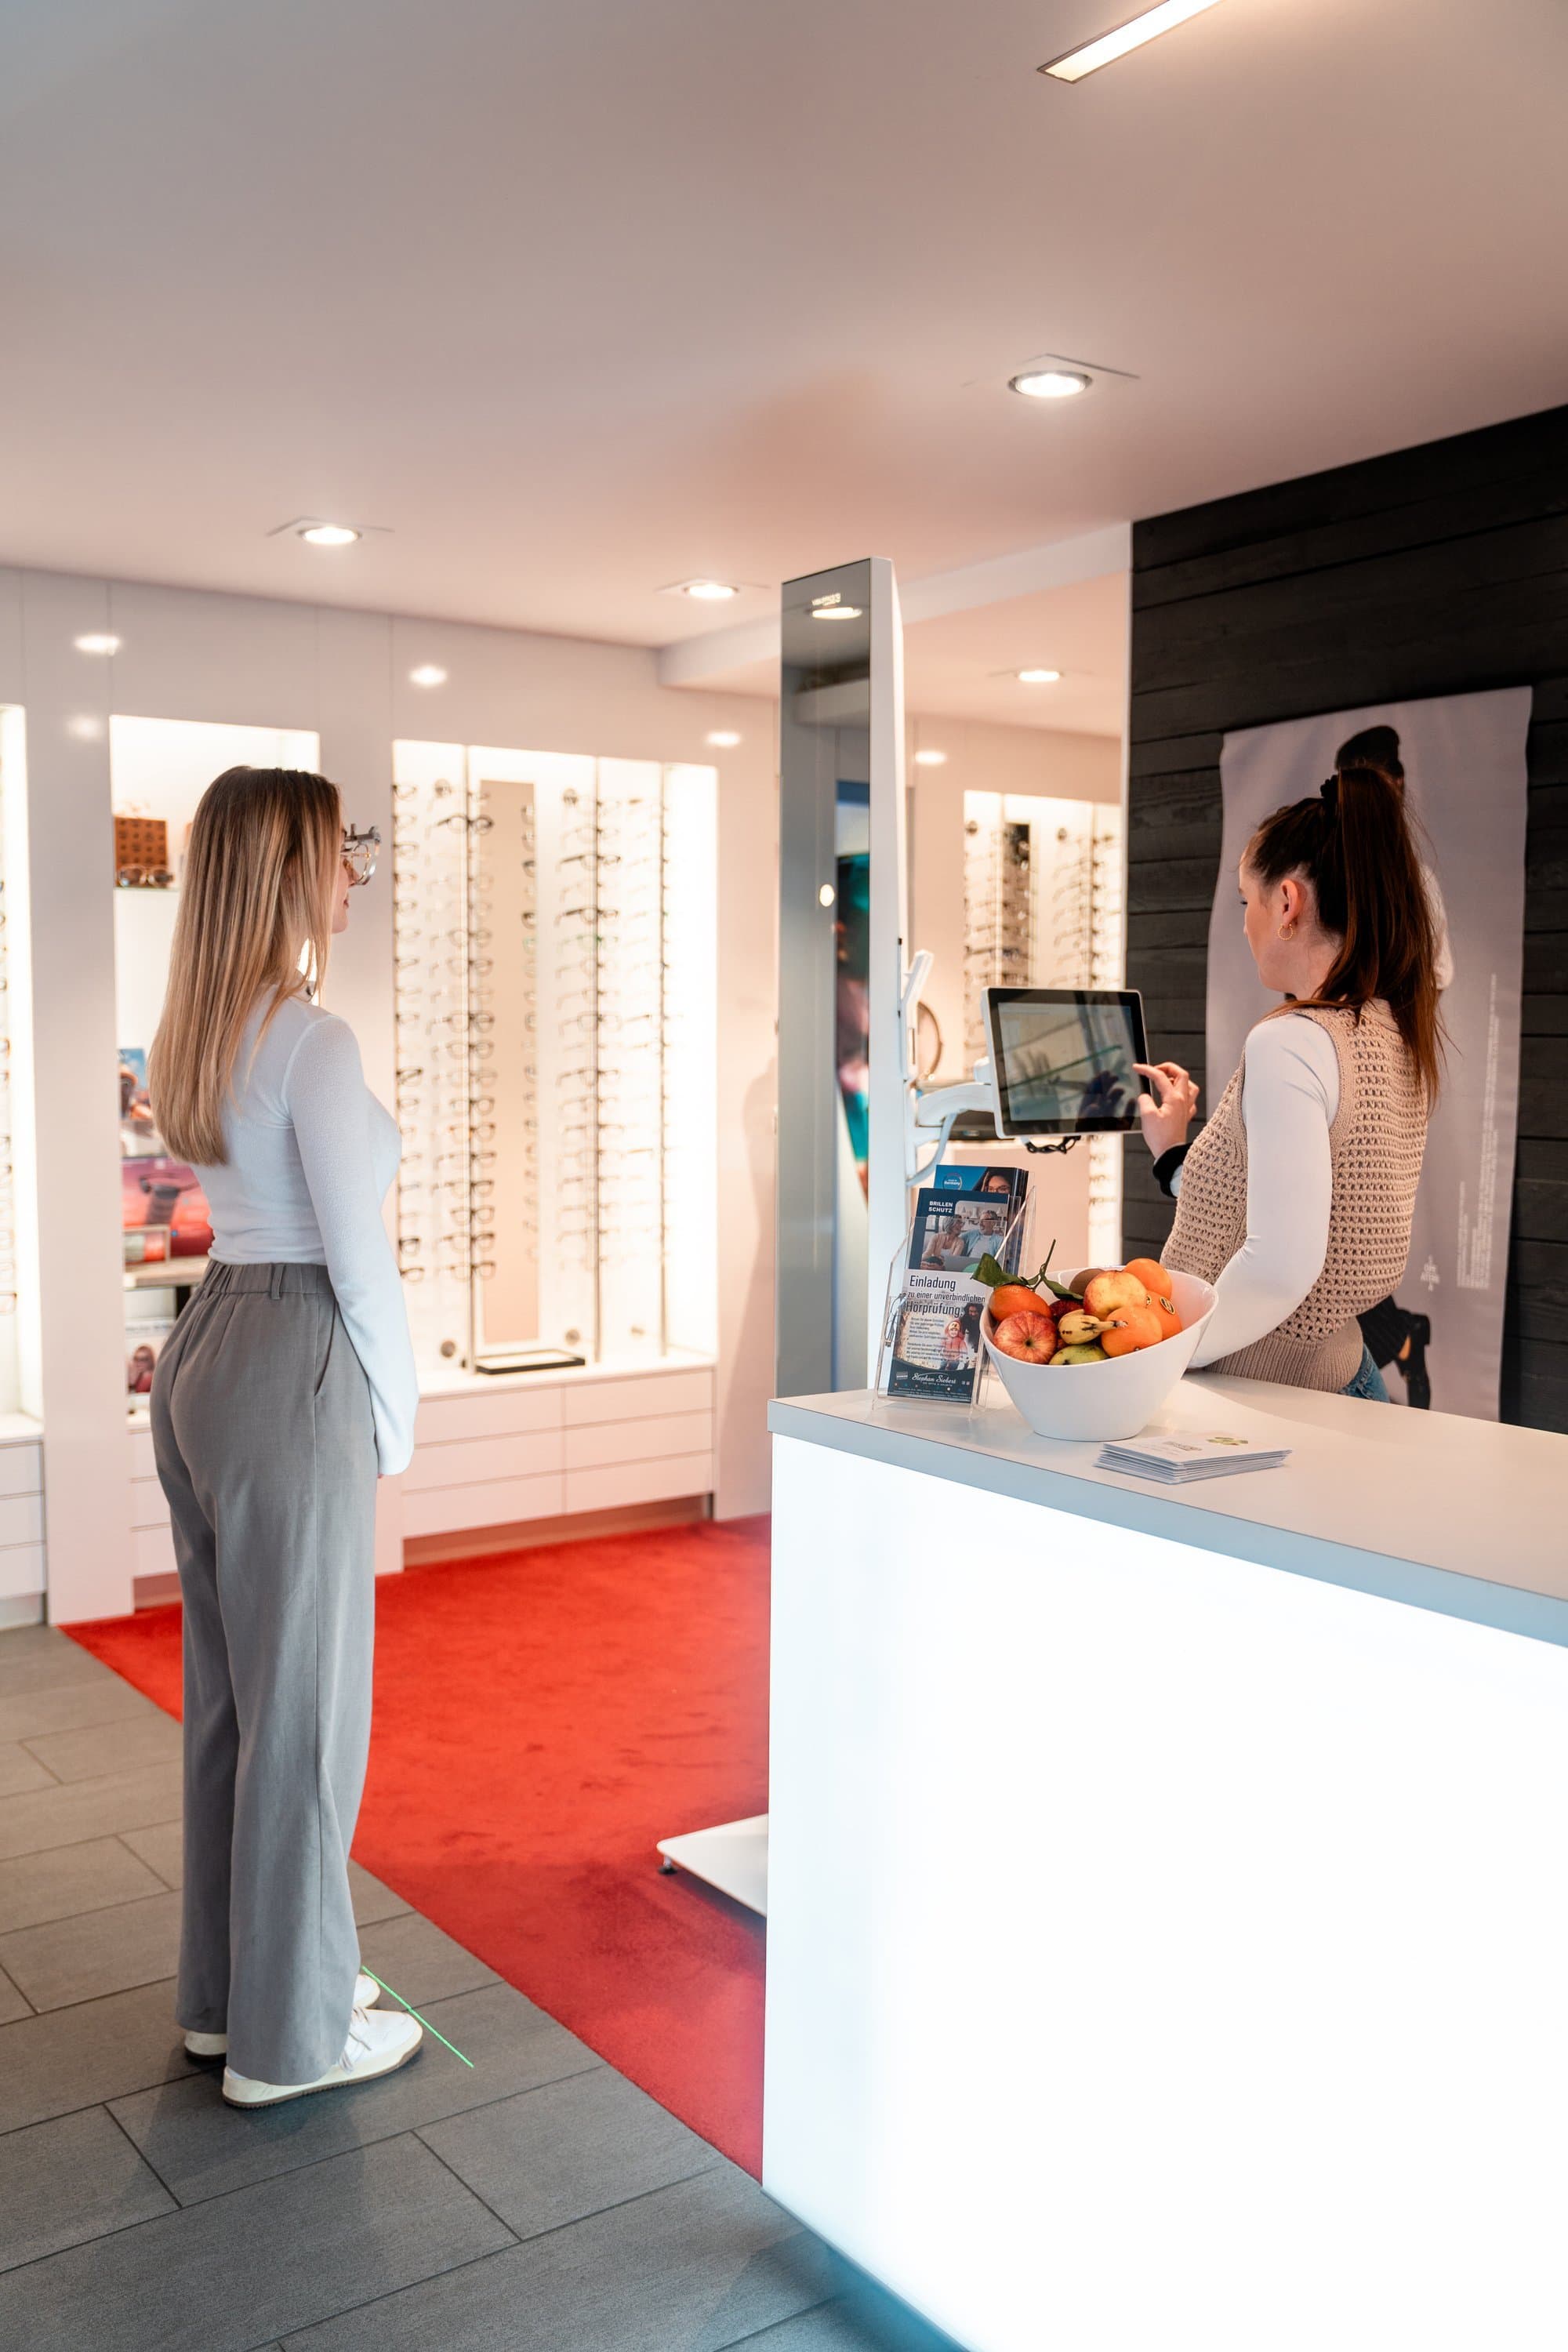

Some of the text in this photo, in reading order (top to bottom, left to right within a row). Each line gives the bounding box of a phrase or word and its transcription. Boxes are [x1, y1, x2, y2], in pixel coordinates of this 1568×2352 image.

[909, 1275, 956, 1291] Einladung
[916, 1290, 932, 1299] einer
[934, 1293, 985, 1303] unverbindlichen
[906, 1301, 964, 1318] Hörprüfung.
